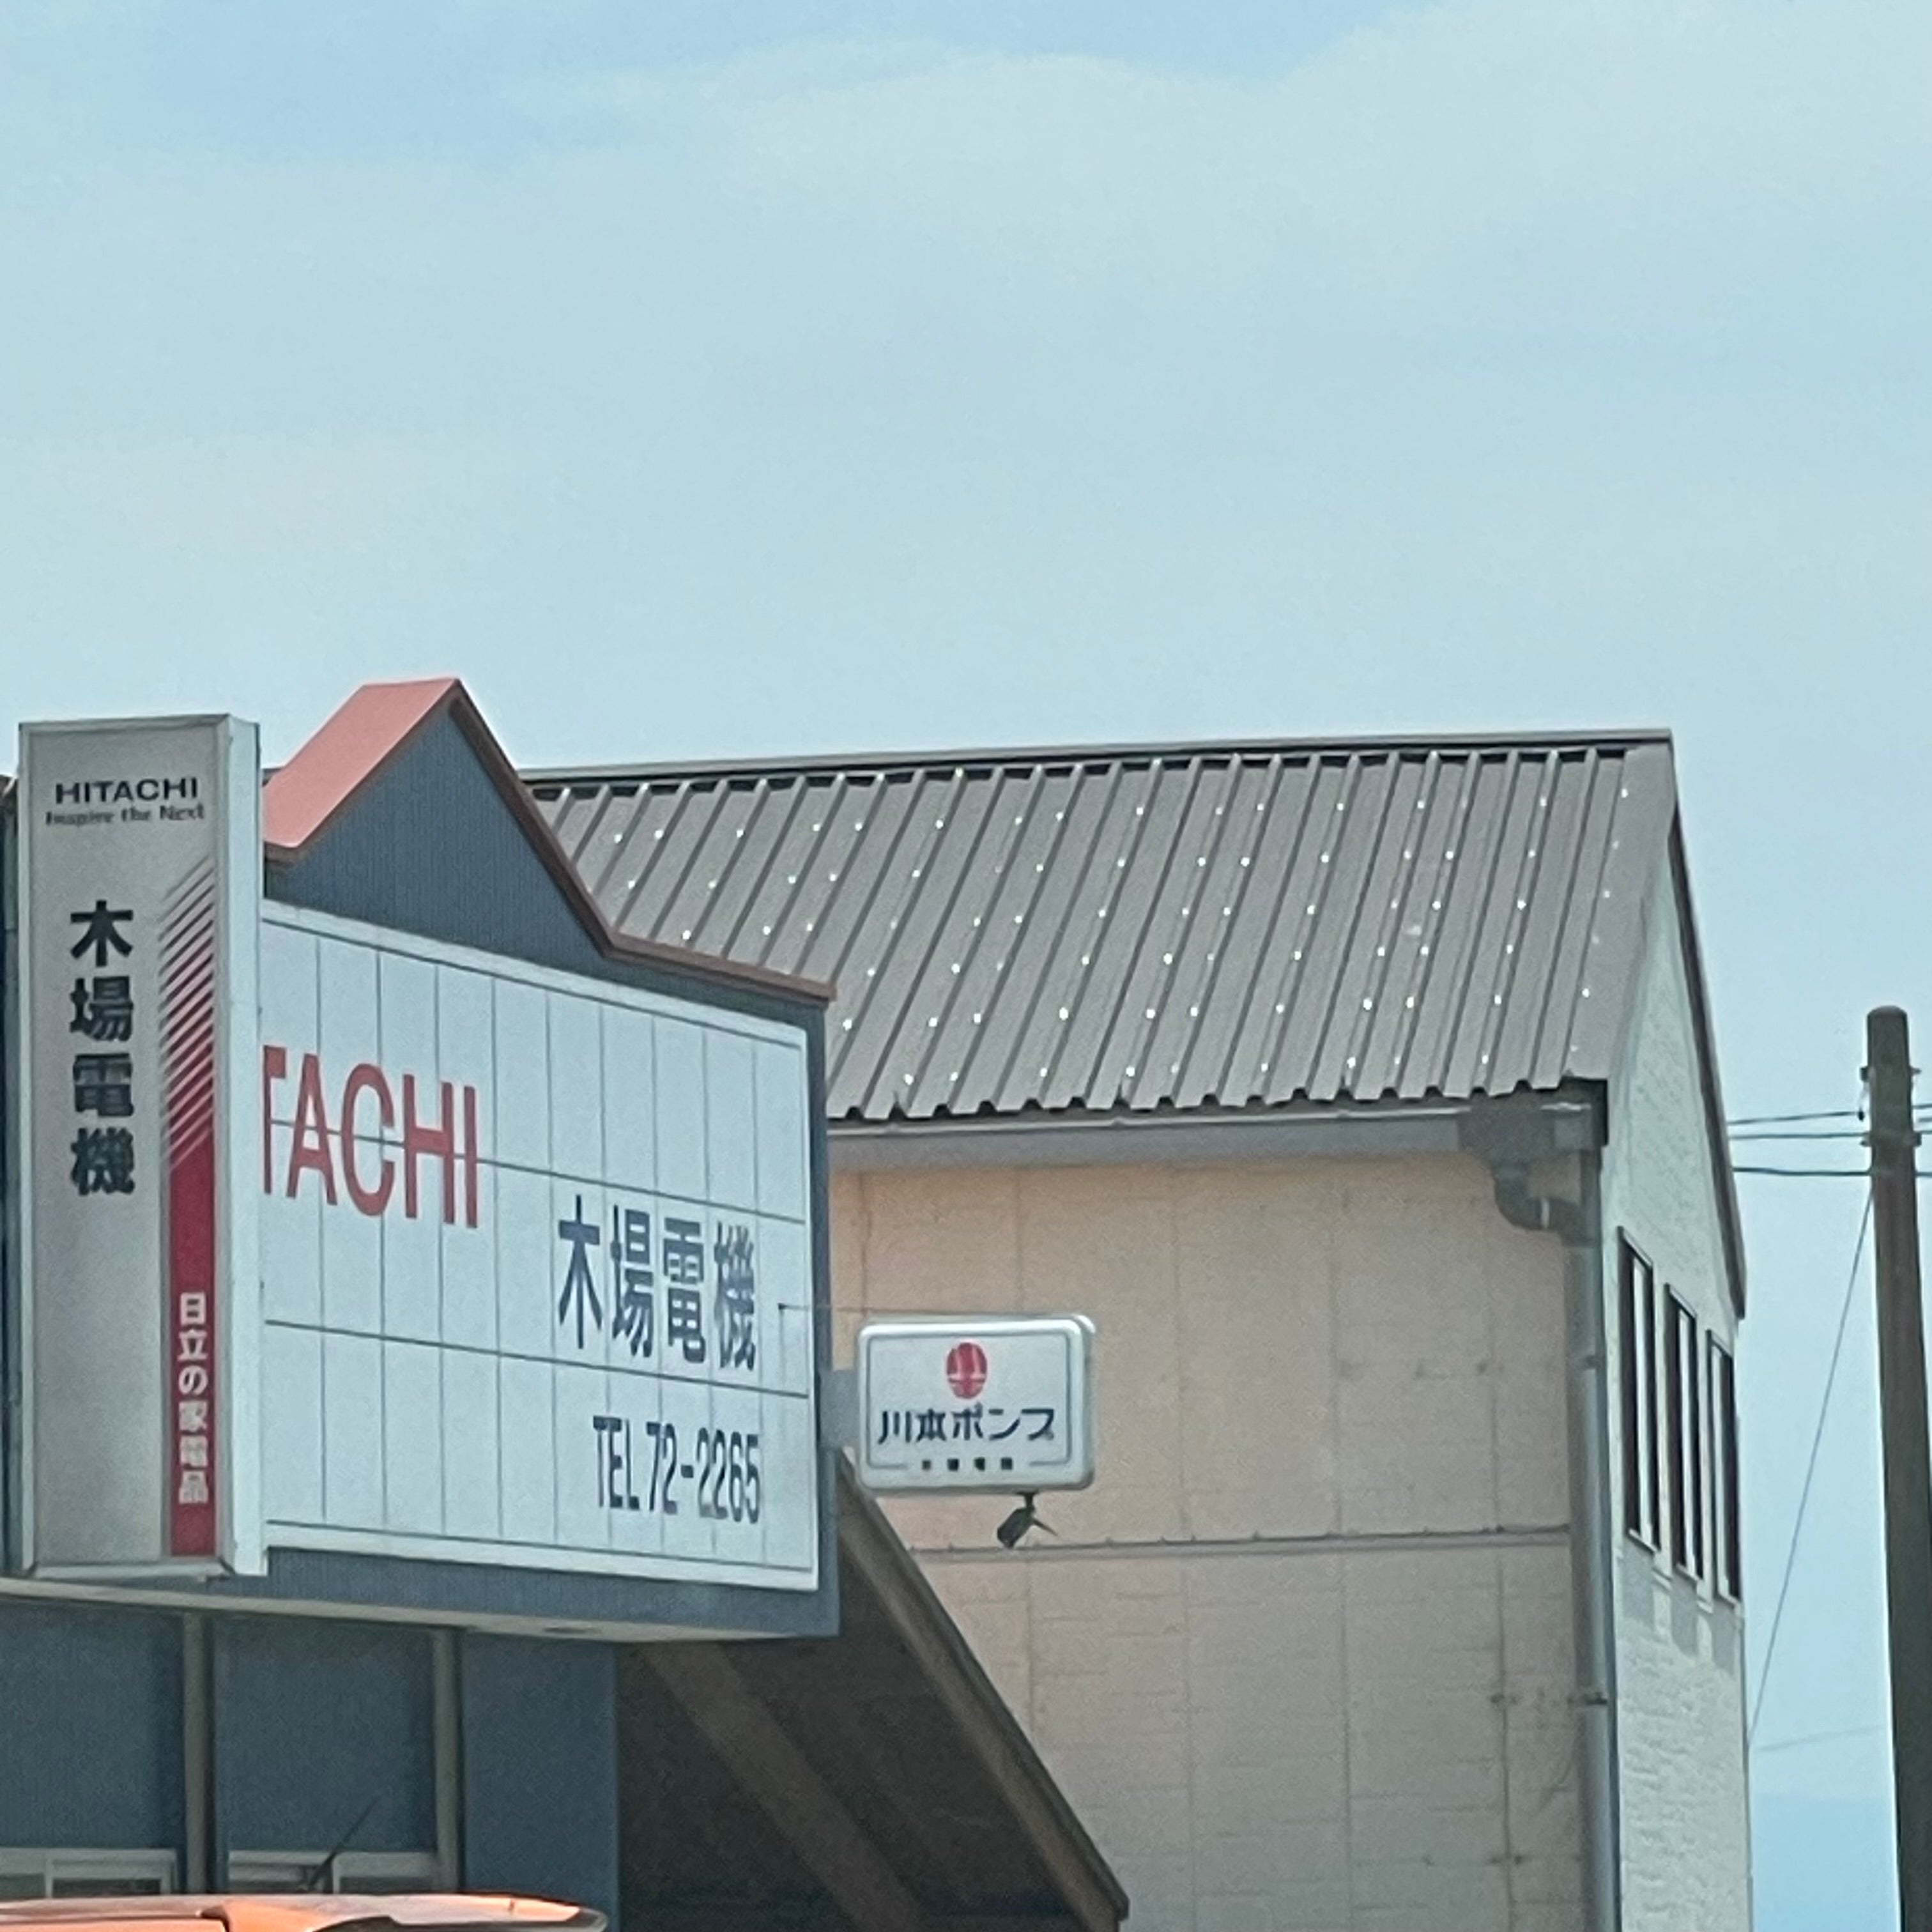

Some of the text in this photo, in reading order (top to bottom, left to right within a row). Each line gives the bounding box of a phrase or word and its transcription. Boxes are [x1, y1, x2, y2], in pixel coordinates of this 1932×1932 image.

[56, 777, 197, 804] HITACHI
[160, 802, 204, 820] Next
[70, 900, 134, 1195] 木場電機
[558, 1195, 755, 1371] 木場電機
[646, 1422, 760, 1524] 72-2265
